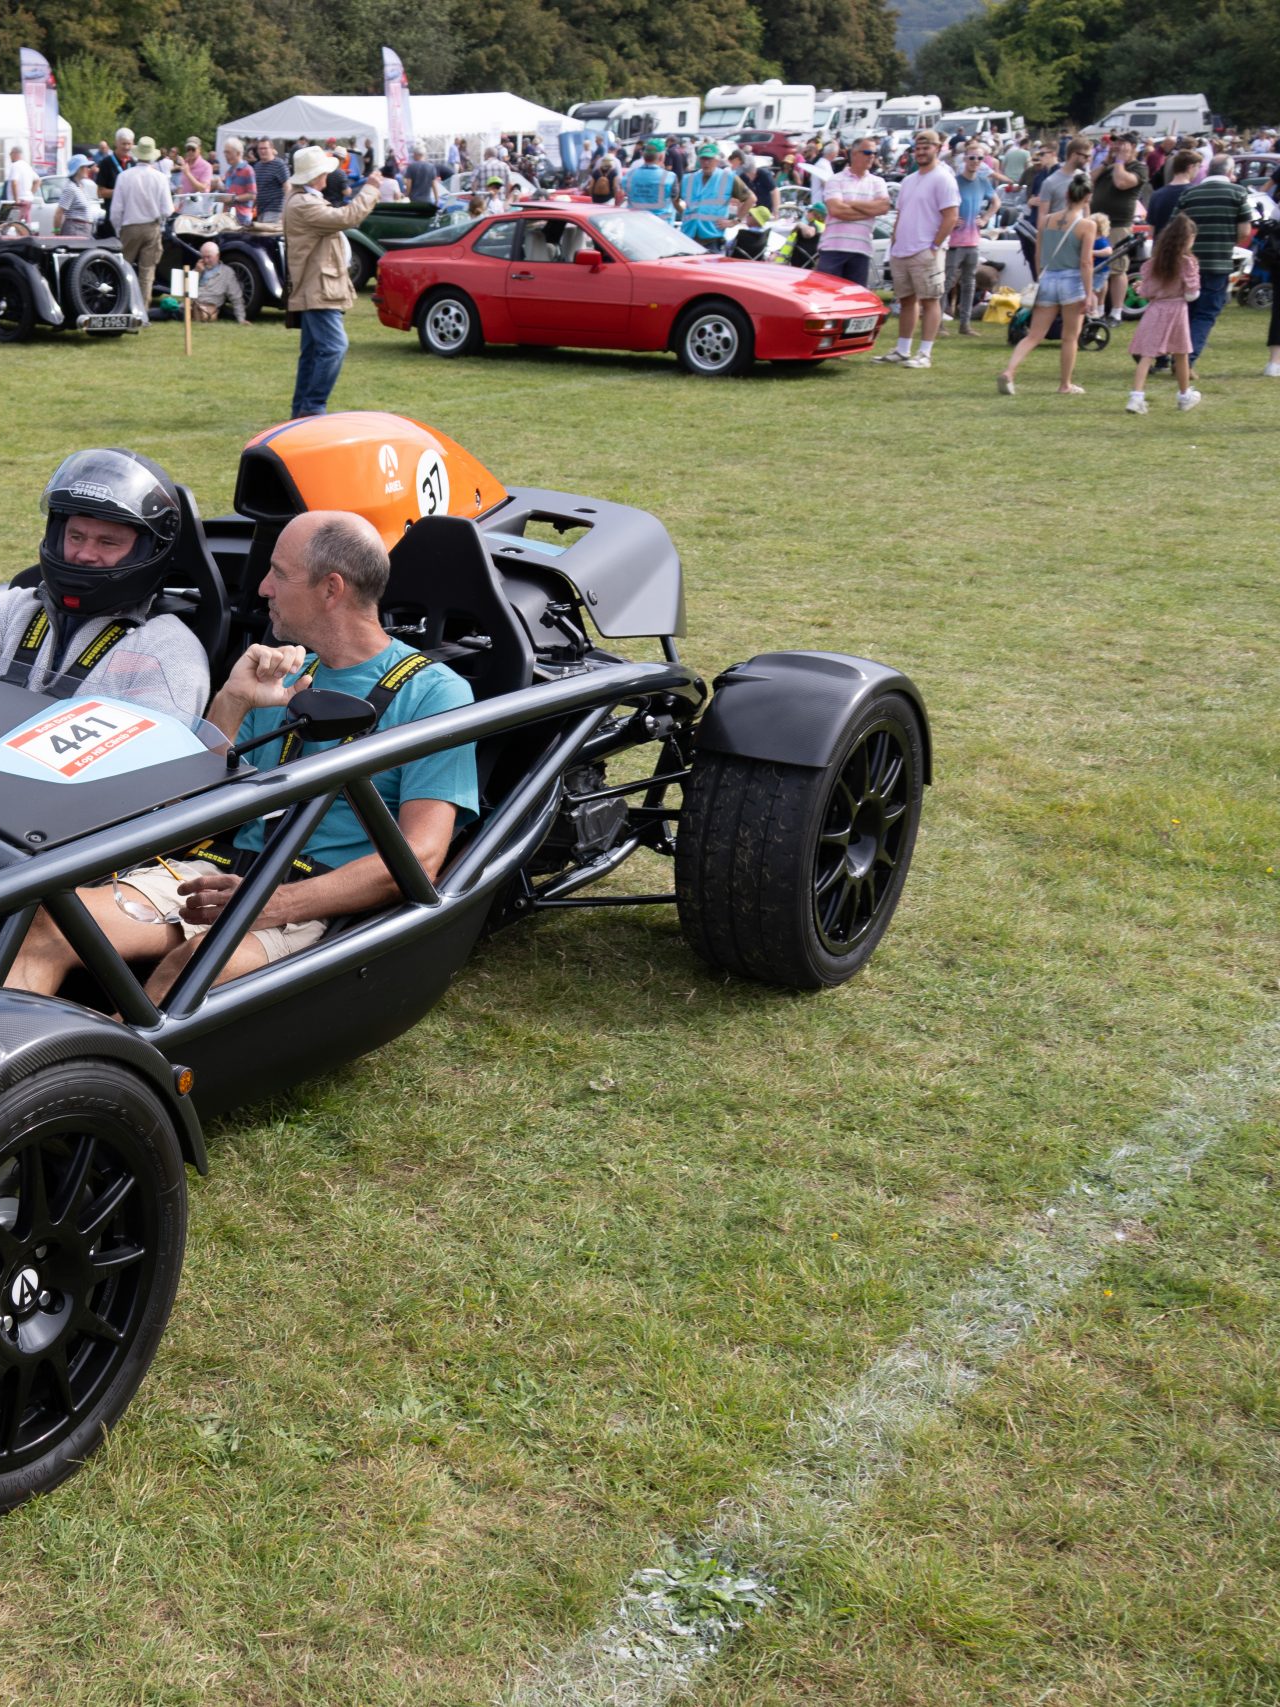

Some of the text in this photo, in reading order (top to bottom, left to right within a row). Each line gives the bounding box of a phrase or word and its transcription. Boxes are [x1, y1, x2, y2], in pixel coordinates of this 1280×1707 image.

[73, 483, 108, 500] SHOEI
[385, 480, 404, 494] ARIEL
[422, 461, 443, 515] 37
[55, 712, 76, 727] Days
[50, 716, 117, 754] 441
[74, 754, 94, 768] Kop
[93, 746, 107, 758] Hill
[105, 732, 130, 748] Climb
